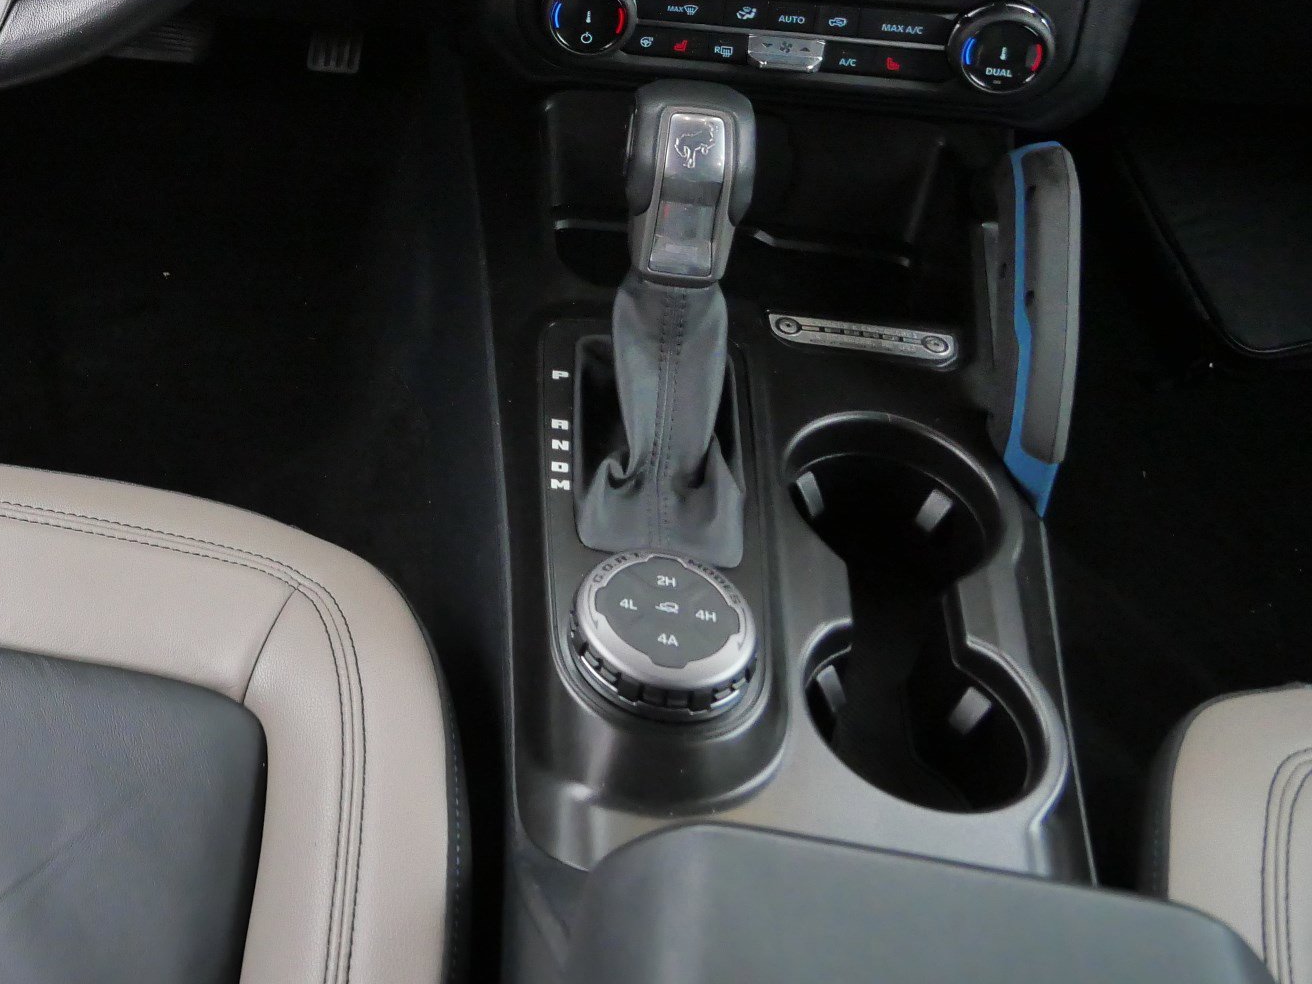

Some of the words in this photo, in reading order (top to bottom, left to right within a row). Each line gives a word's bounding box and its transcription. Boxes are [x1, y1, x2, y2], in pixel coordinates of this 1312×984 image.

[667, 5, 684, 13] MAX
[778, 14, 806, 24] AUTO
[881, 23, 904, 33] MAX
[905, 25, 924, 35] A/C
[838, 58, 857, 67] A/C
[985, 67, 1013, 78] DUAL
[551, 369, 570, 380] P
[551, 439, 570, 451] N
[551, 461, 569, 473] D
[550, 478, 571, 491] M
[656, 575, 677, 587] 2H
[619, 598, 638, 611] 4L
[695, 609, 717, 623] 4H
[657, 633, 679, 647] 4A
